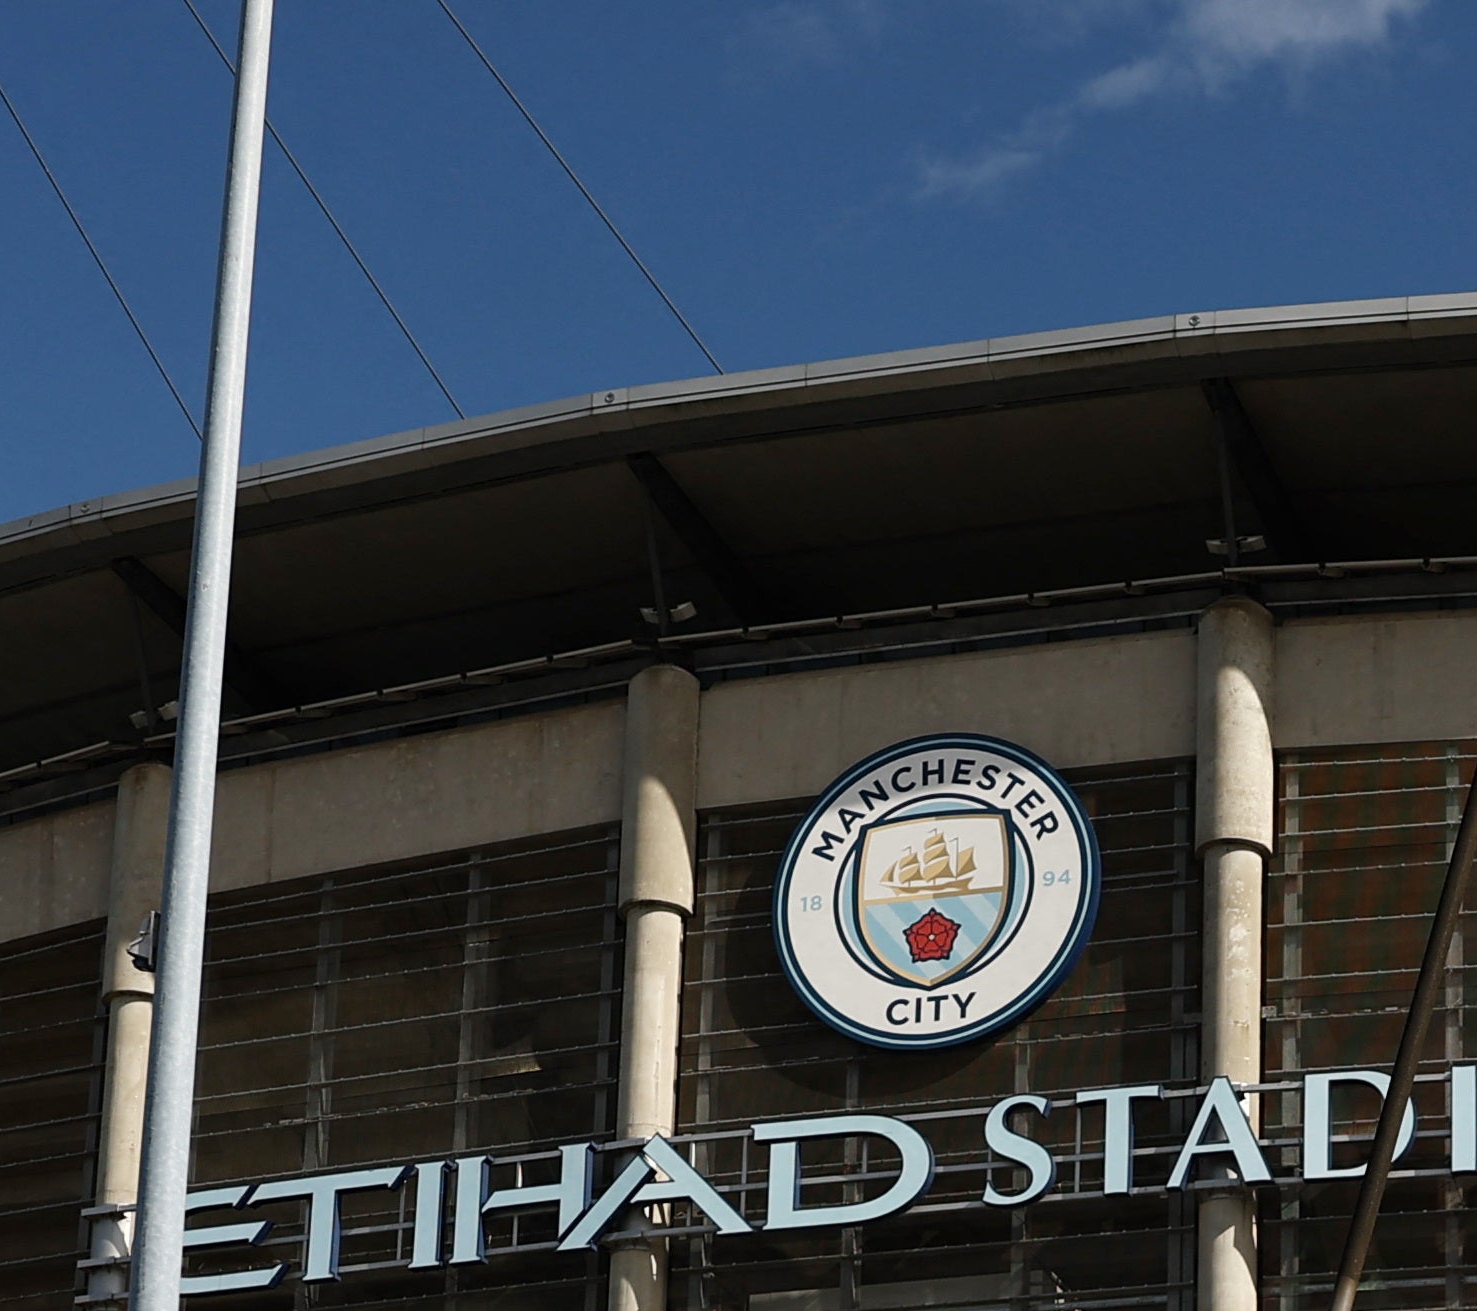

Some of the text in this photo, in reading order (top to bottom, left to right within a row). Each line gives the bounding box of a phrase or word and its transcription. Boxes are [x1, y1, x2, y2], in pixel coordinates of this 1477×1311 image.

[812, 760, 1059, 862] MANCHESTER
[800, 870, 1071, 911] 18 94
[885, 992, 976, 1026] CITY
[179, 1113, 935, 1294] ETIHAD
